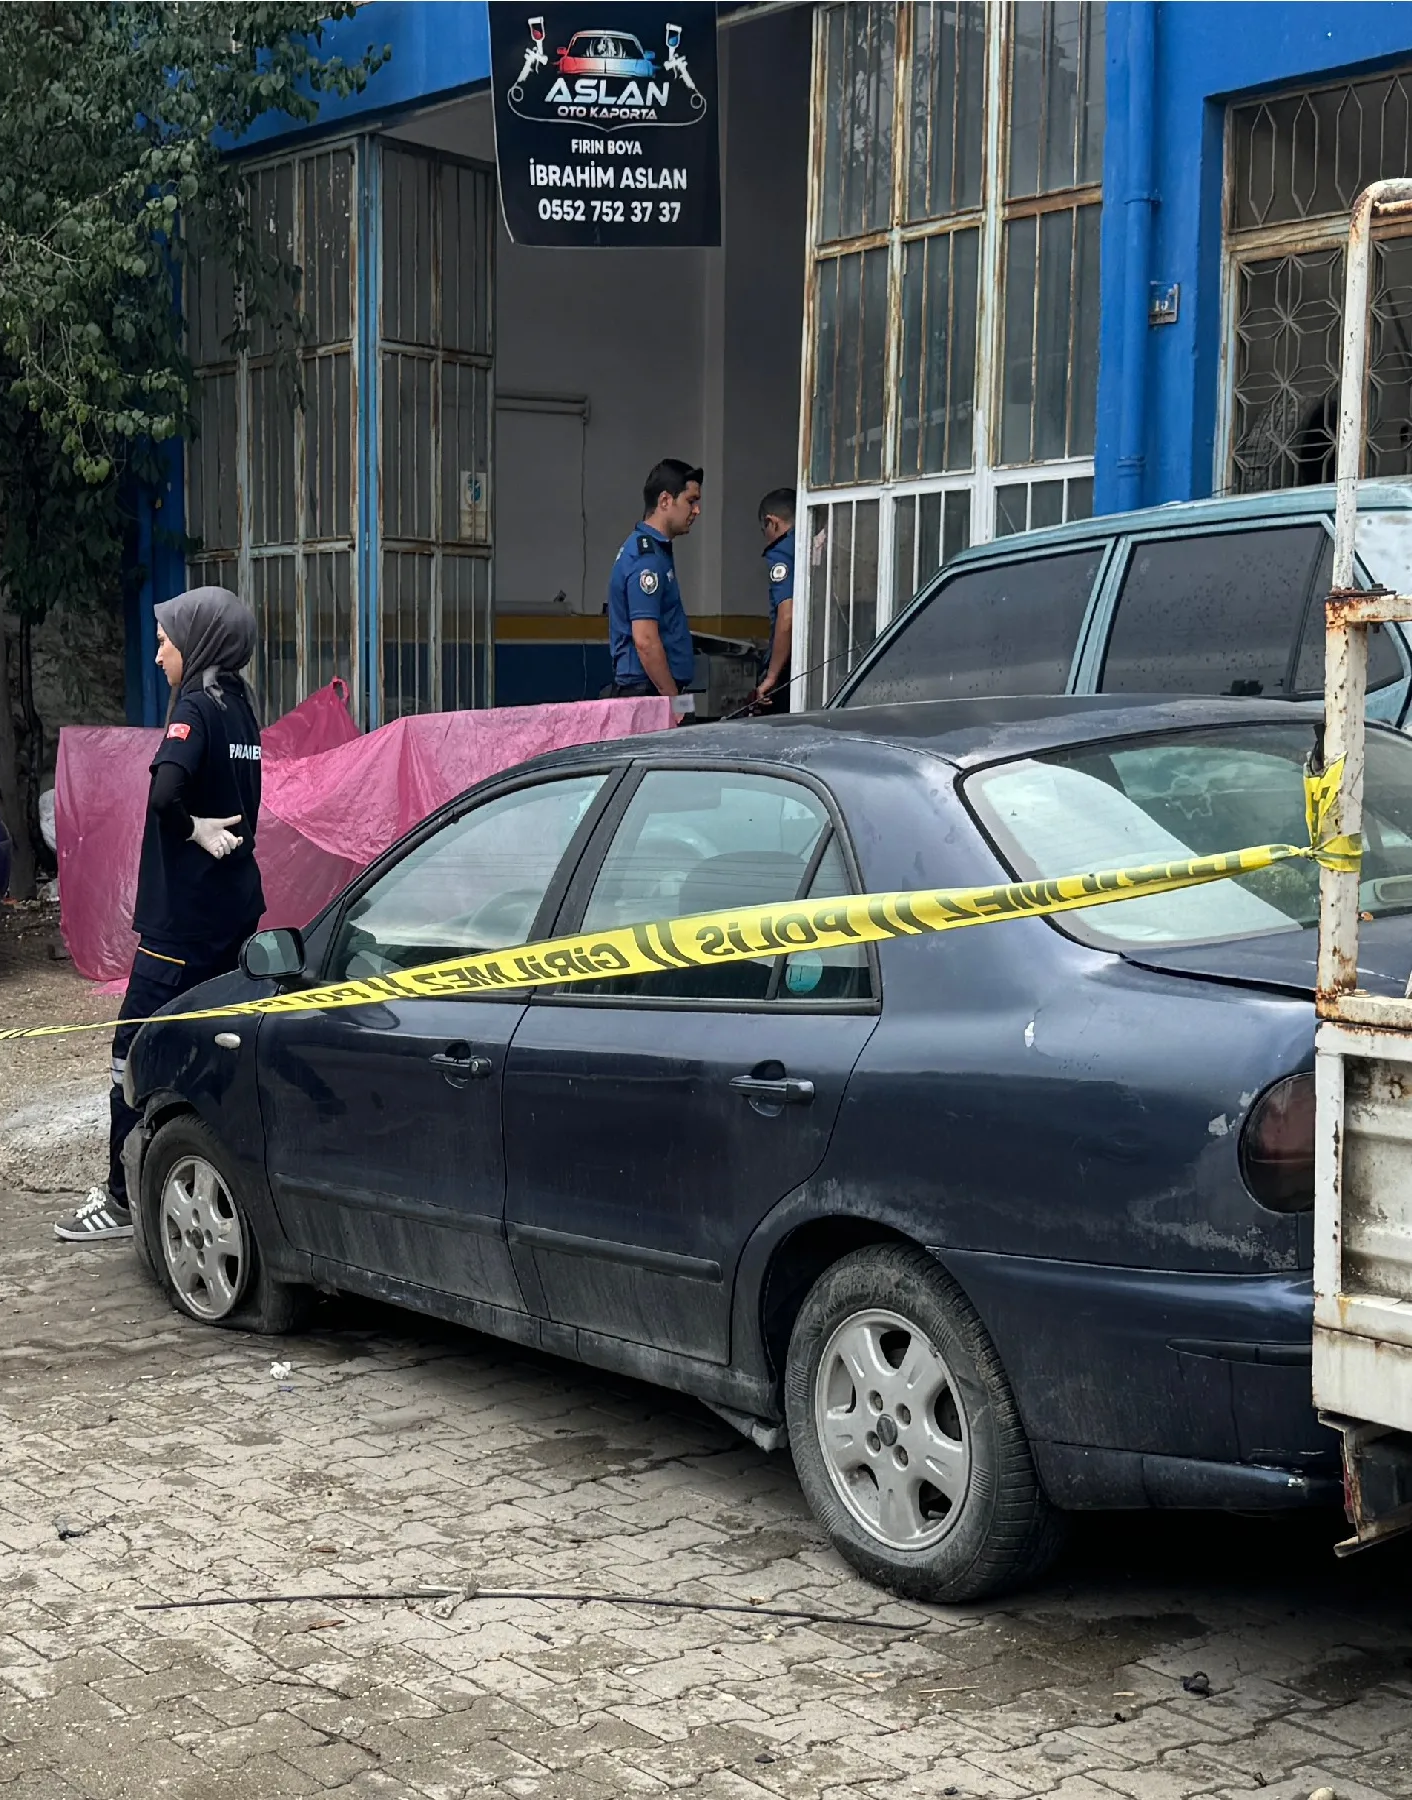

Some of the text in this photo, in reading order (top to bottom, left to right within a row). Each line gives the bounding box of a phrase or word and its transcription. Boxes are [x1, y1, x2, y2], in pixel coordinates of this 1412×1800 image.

[544, 77, 670, 107] ASLAN
[557, 105, 658, 120] OTO KAPORTA
[571, 139, 642, 155] FIRIN BOYA
[529, 157, 687, 190] İBRAHİM ASLAN
[538, 198, 681, 223] 0552 752 37 37
